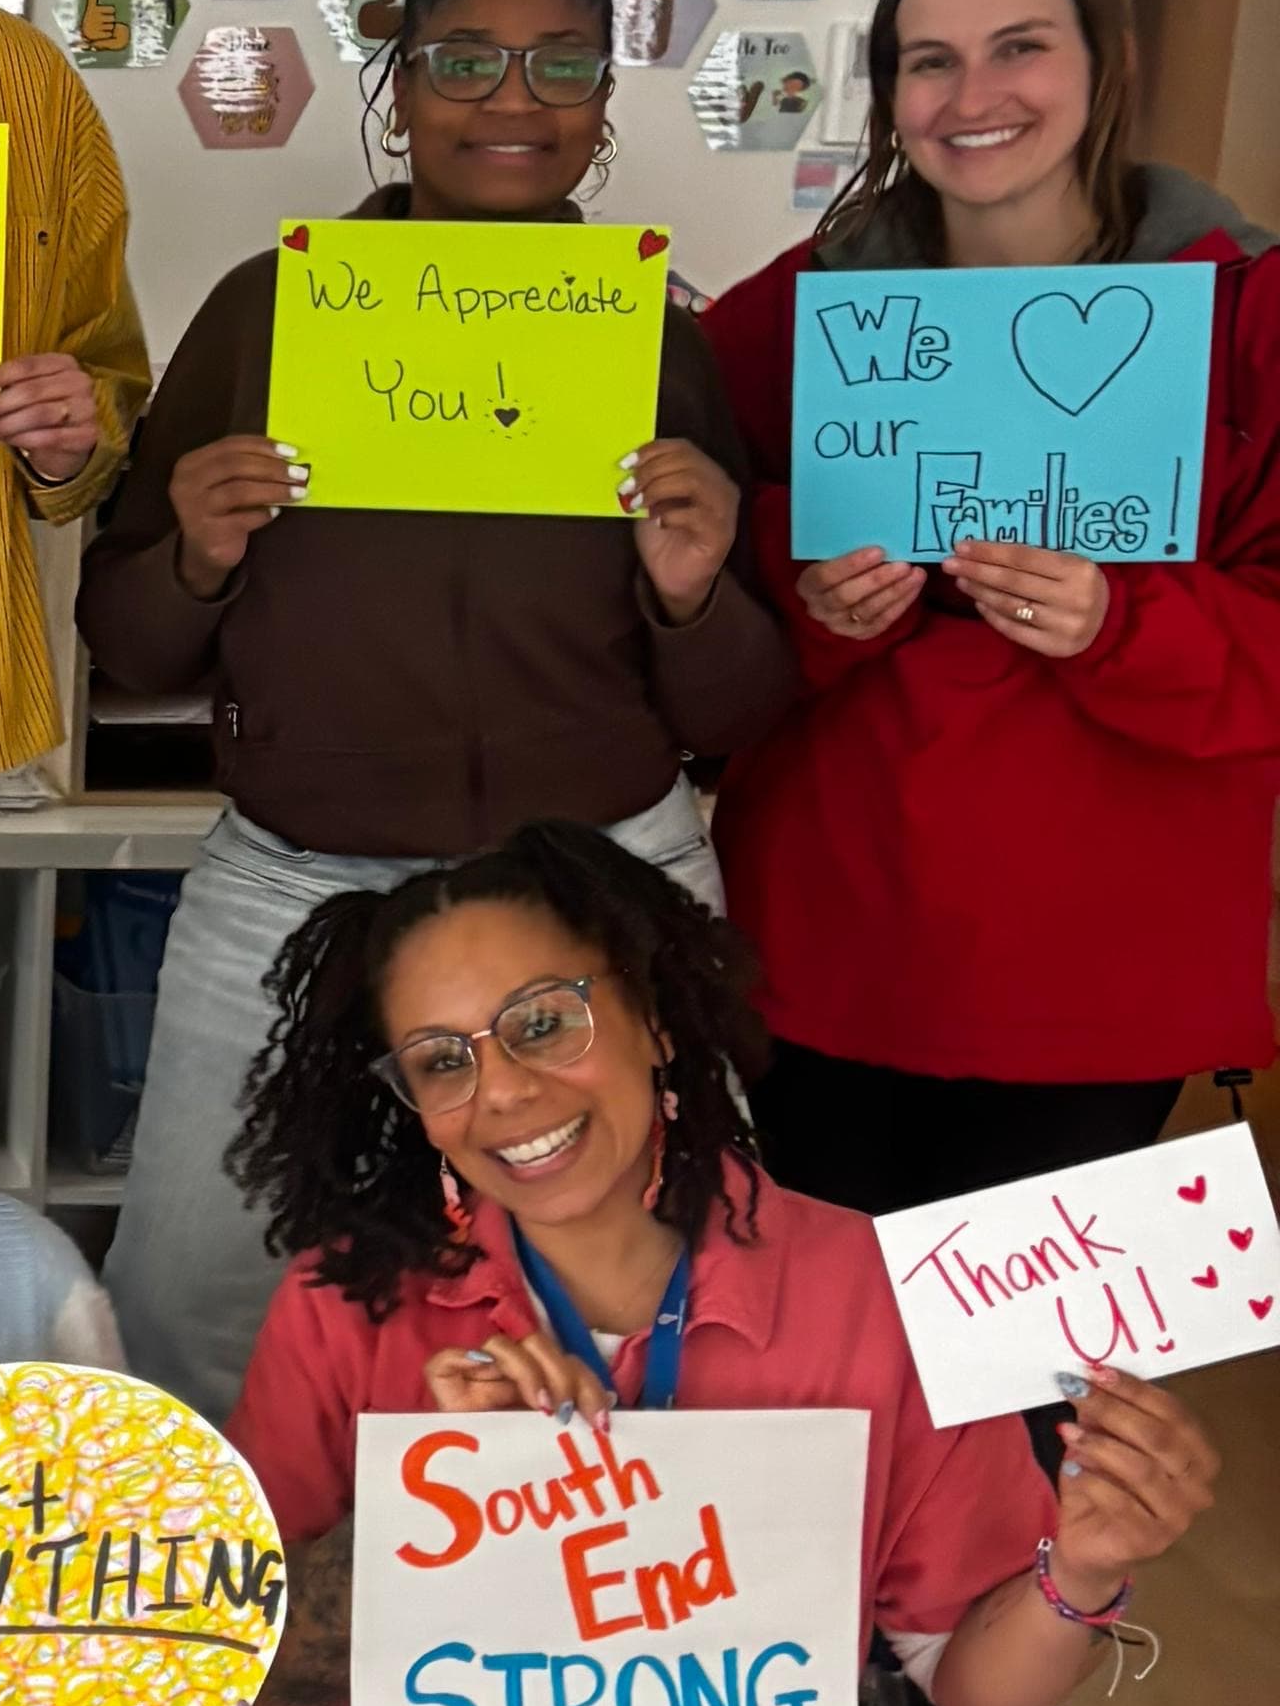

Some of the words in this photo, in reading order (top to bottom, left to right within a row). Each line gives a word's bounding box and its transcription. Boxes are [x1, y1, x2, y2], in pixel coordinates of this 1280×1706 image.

[306, 261, 383, 312] We
[416, 263, 638, 324] Appreciate
[816, 295, 952, 386] We
[814, 420, 919, 459] our
[901, 1195, 1126, 1317] Thank
[395, 1428, 663, 1568] South
[560, 1504, 737, 1641] End
